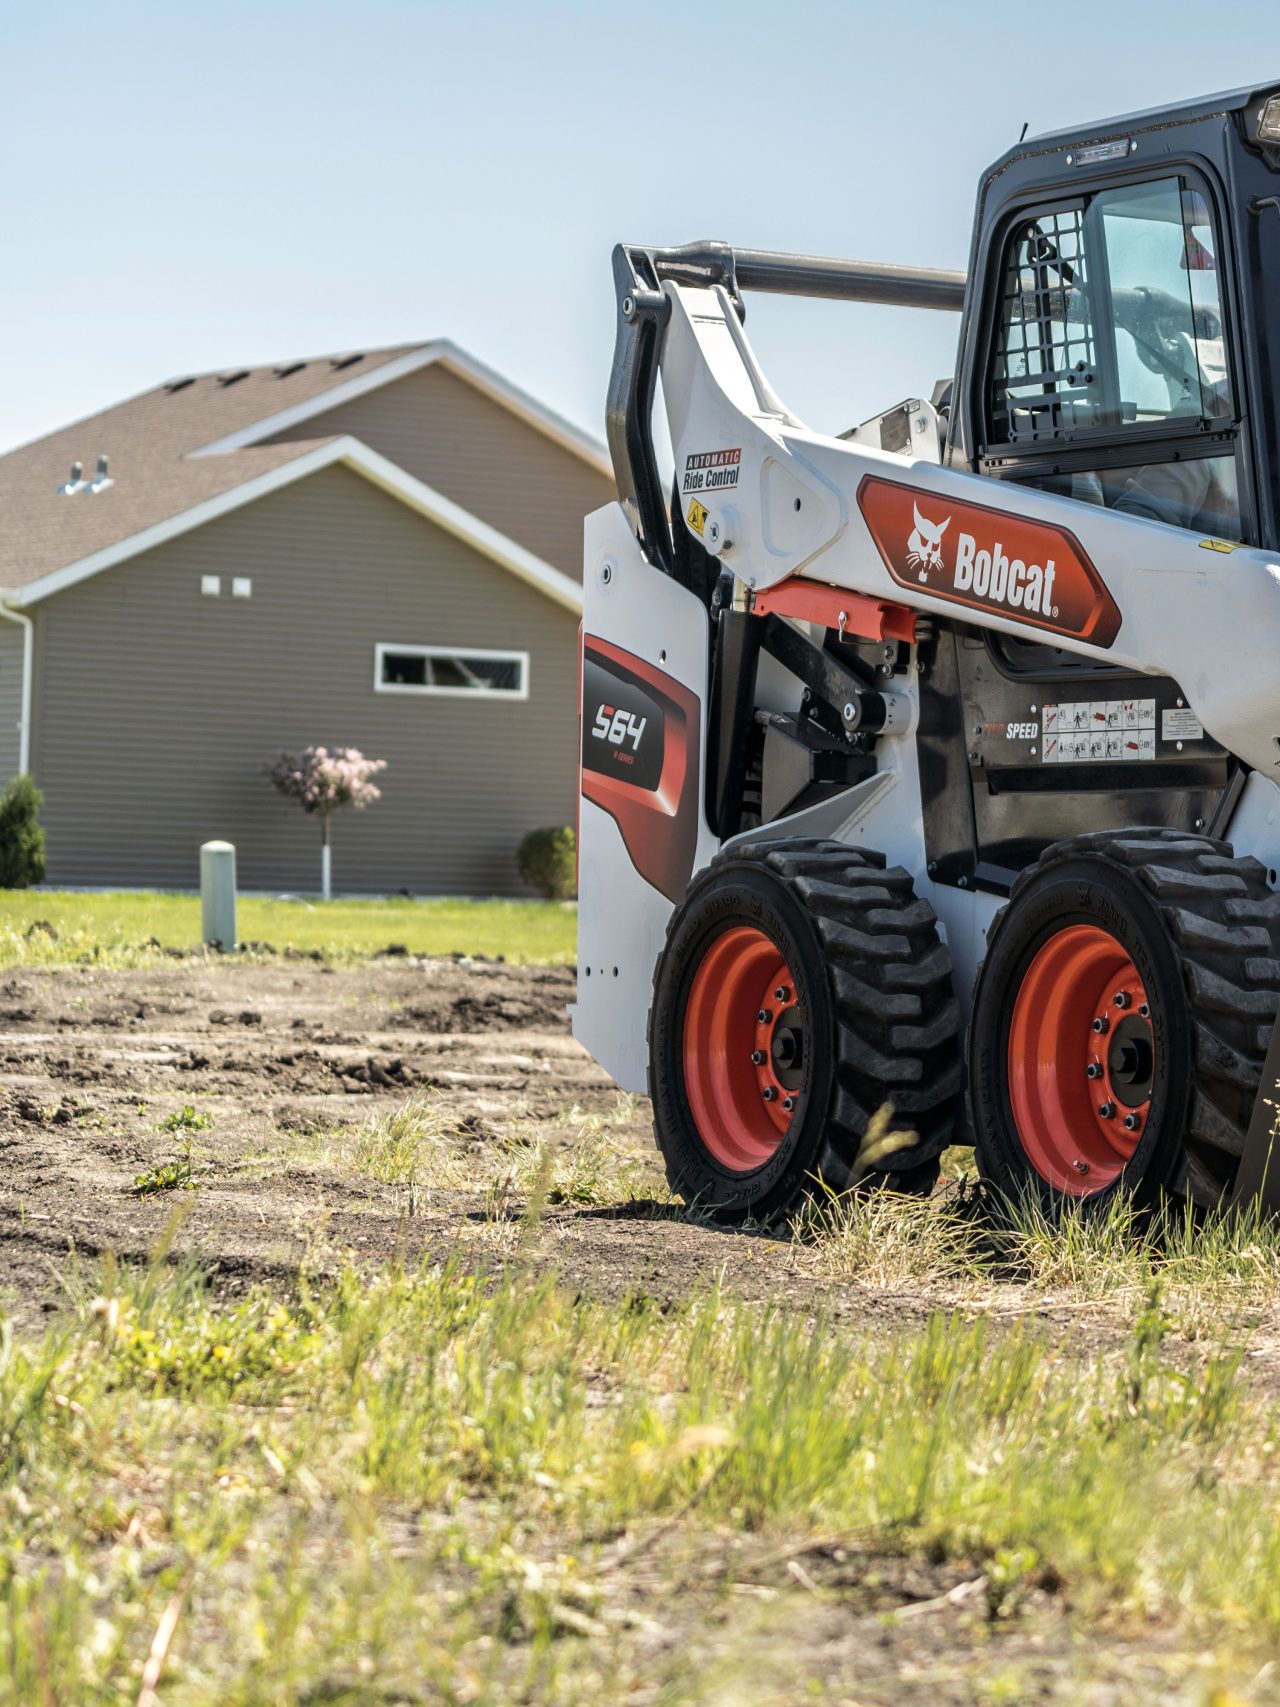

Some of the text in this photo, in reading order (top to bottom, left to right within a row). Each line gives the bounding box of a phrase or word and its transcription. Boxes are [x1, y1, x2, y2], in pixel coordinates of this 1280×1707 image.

[687, 450, 740, 469] AUTOMATIC
[683, 465, 740, 491] Ride Control
[953, 532, 1056, 617] Bobcat
[591, 703, 647, 751] S64
[1006, 722, 1039, 740] SPEED
